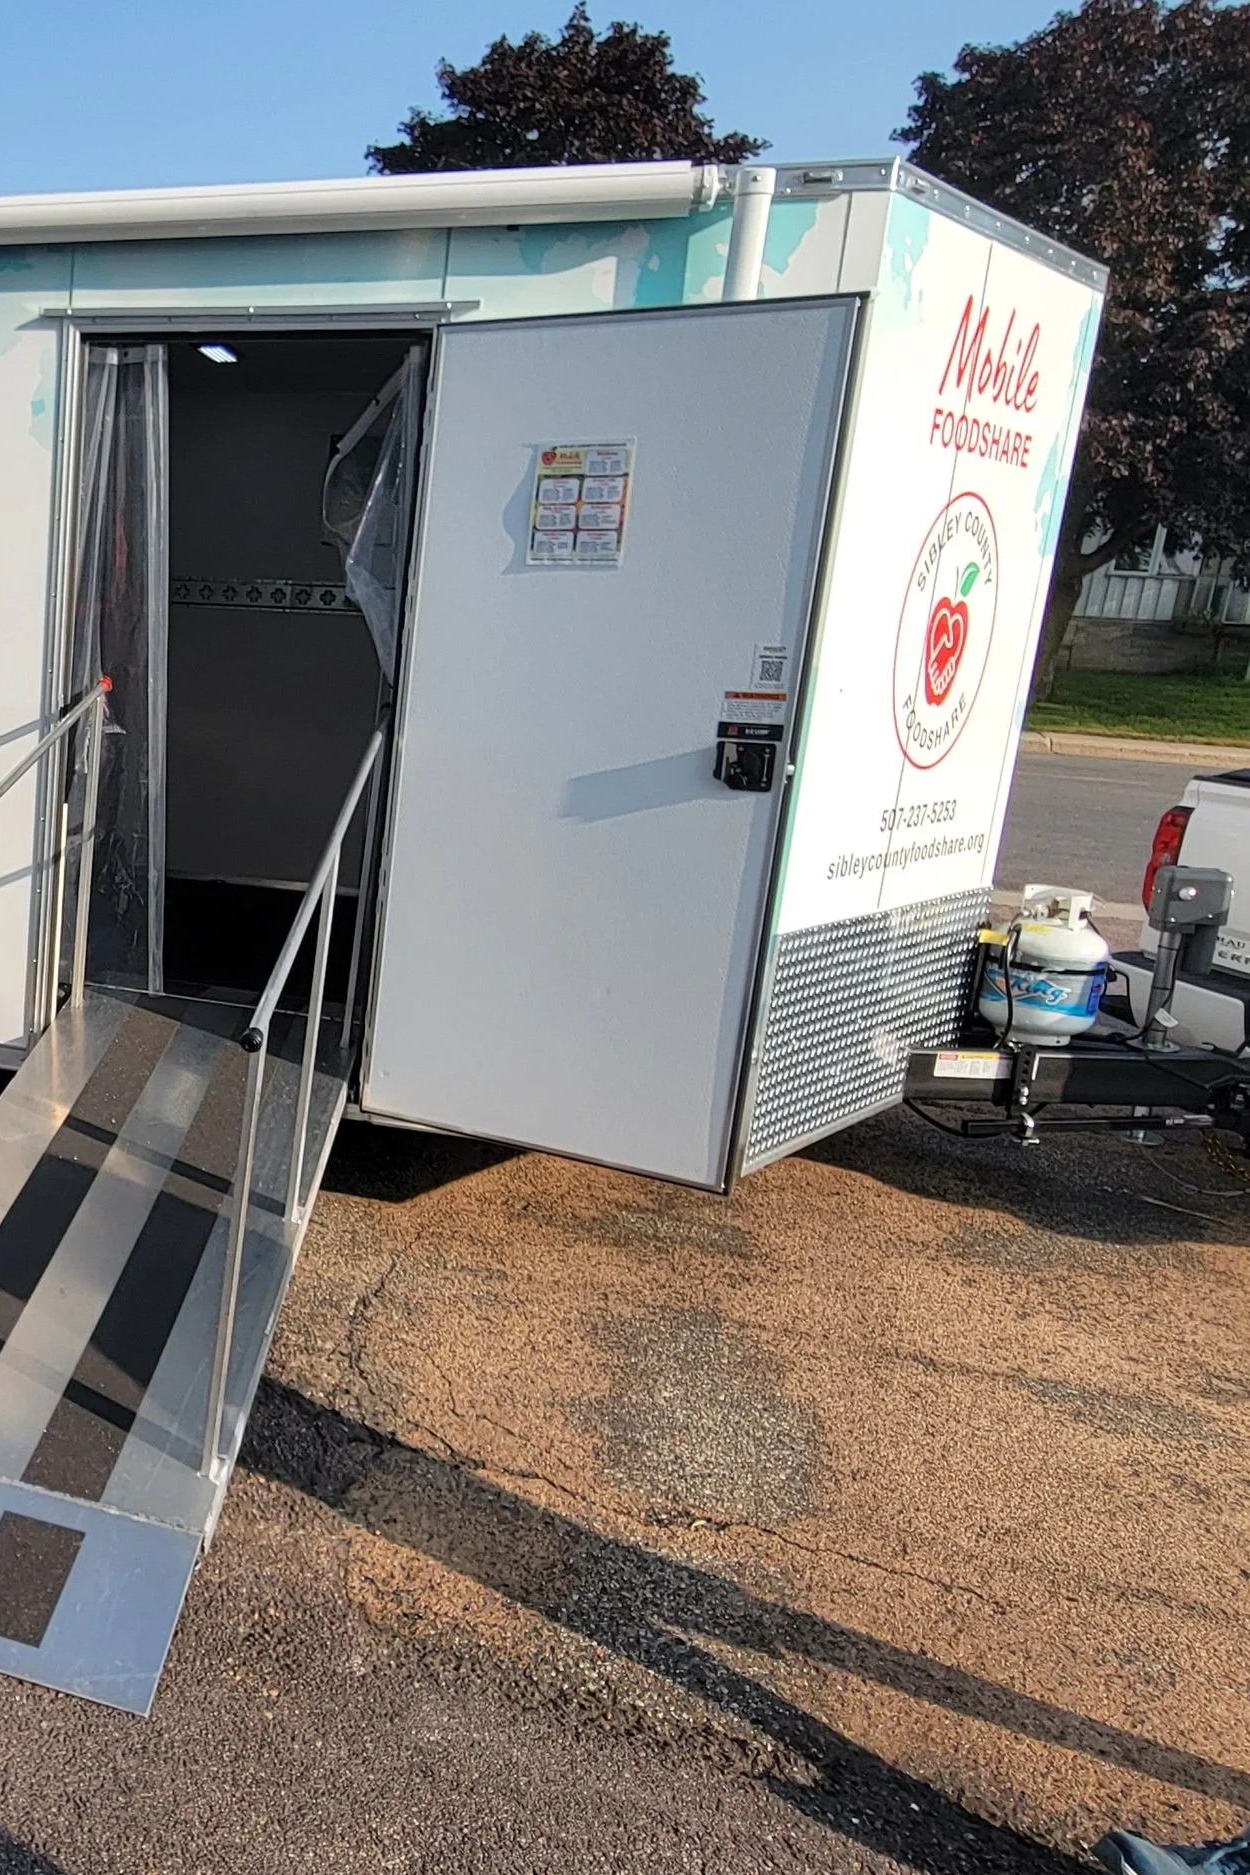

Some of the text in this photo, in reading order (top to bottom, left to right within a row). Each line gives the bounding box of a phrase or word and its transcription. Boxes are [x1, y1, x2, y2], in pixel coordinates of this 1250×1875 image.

[938, 294, 1040, 412] Mobile
[930, 408, 1032, 468] FOODSHARE
[917, 511, 992, 592] SIBLEY COUNTY
[903, 692, 966, 750] FOODSHARE
[879, 799, 957, 833] 507-237-5253
[827, 833, 985, 880] sibleycountyfoodshare.org
